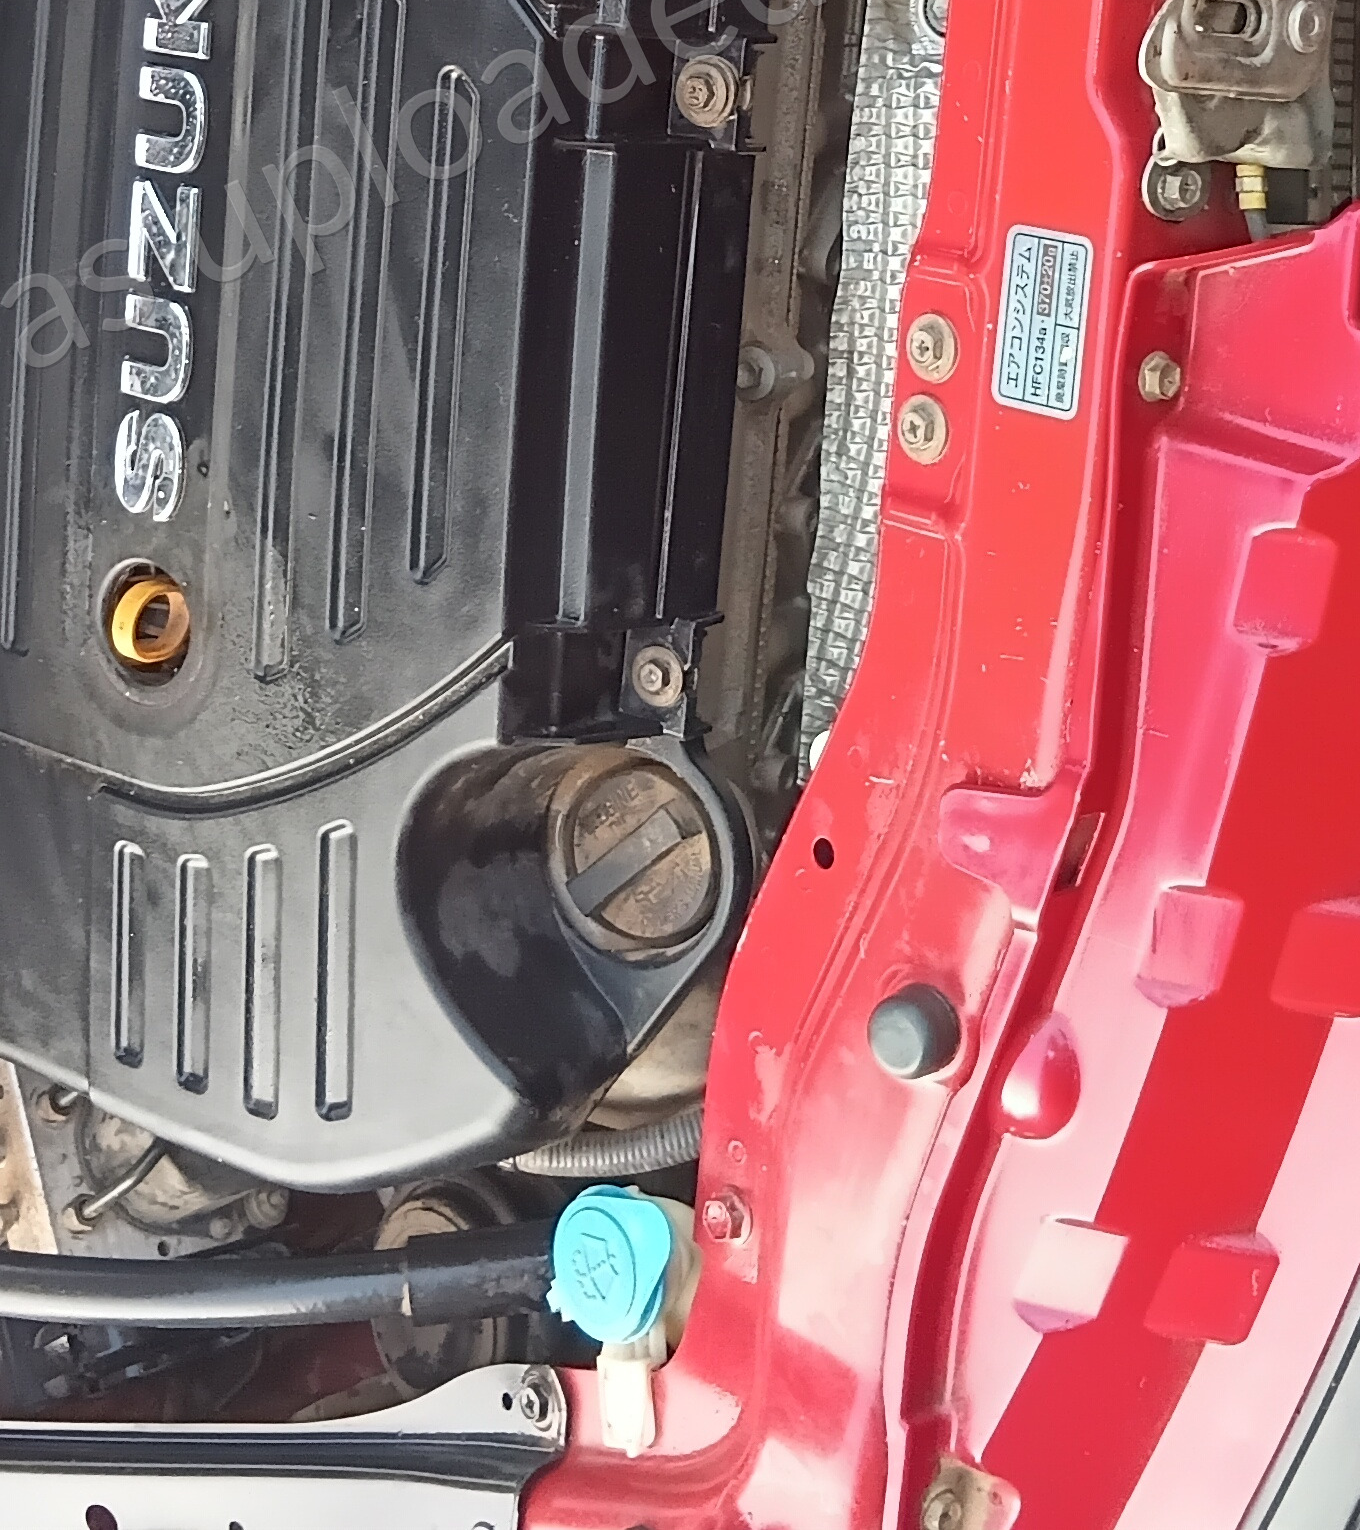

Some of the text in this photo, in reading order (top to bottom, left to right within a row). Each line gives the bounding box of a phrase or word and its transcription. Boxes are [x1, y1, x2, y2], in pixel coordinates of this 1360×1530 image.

[1006, 245, 1033, 389] エアコンシステム
[1061, 249, 1079, 322] 大気放出禁止
[1030, 326, 1048, 398] HFC134a
